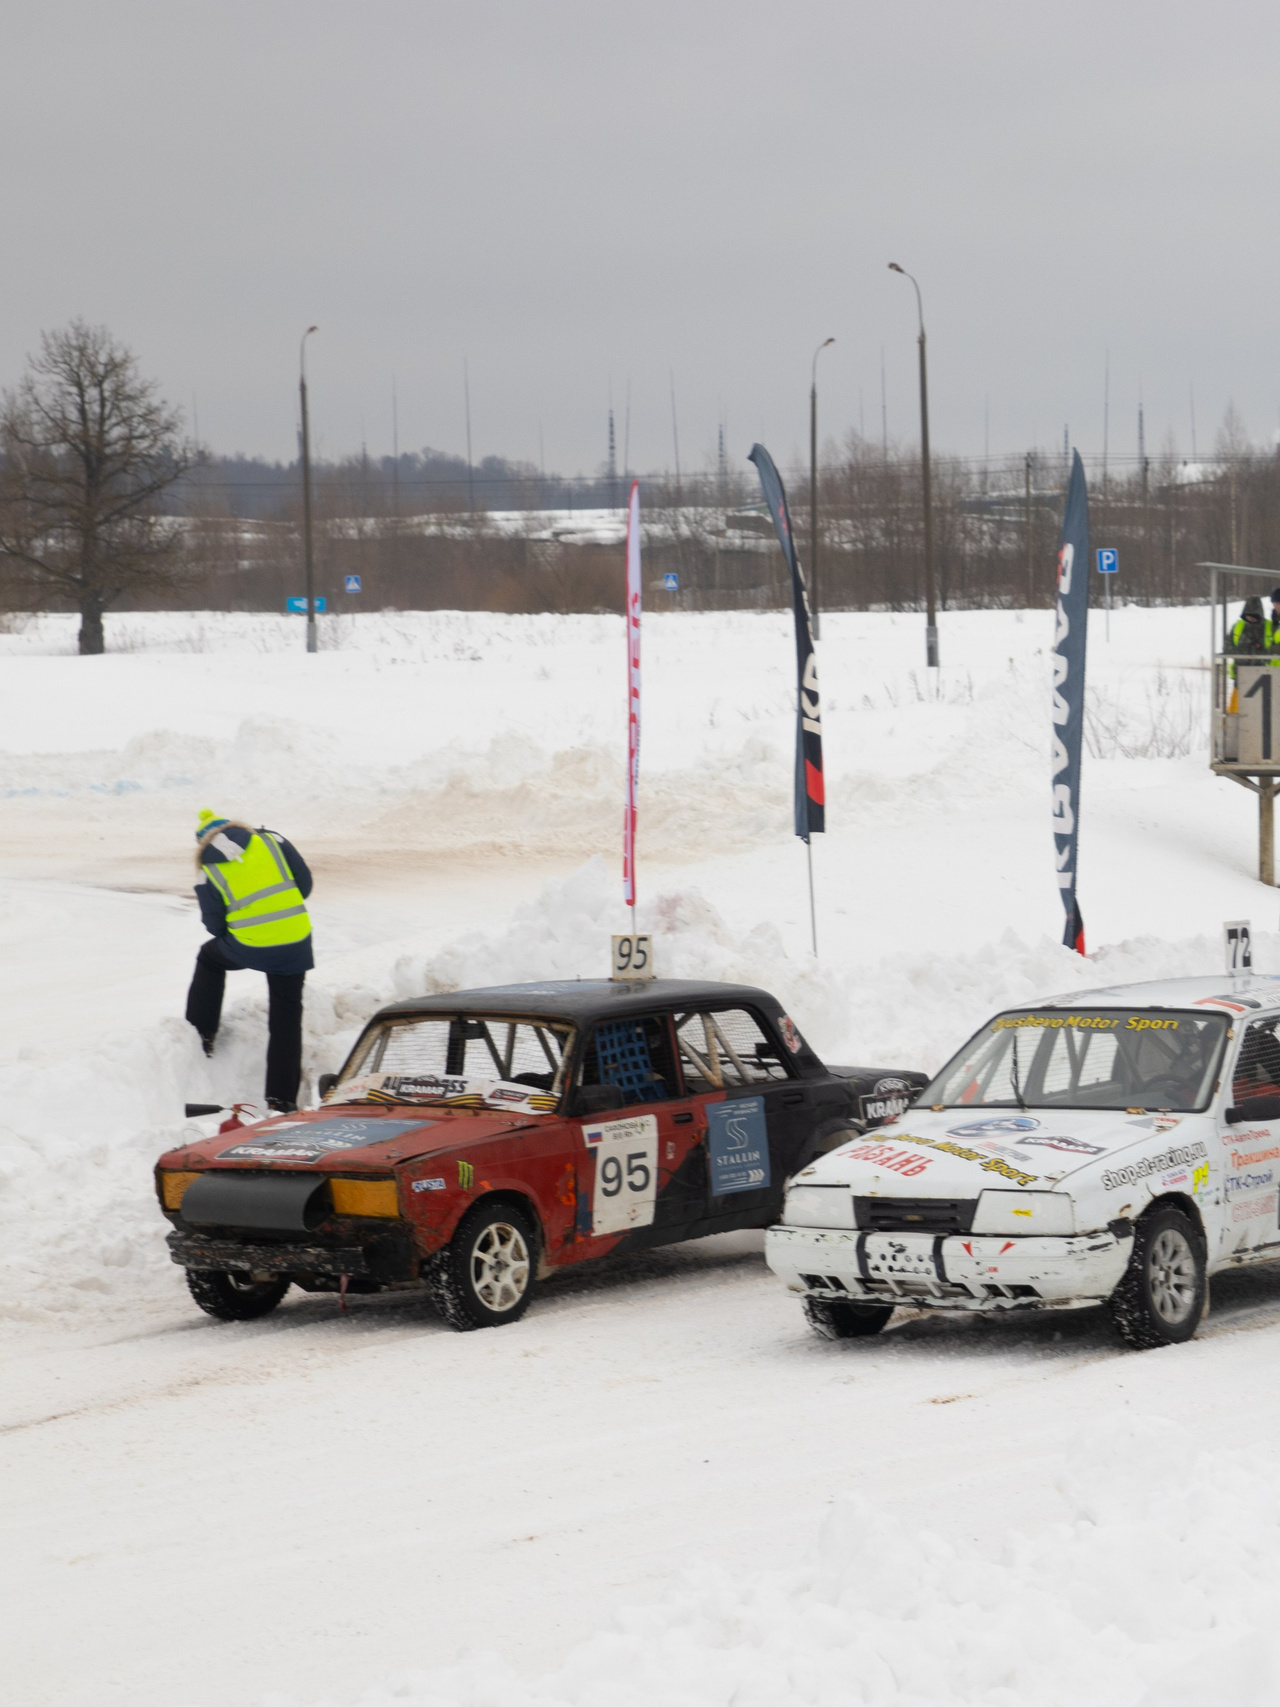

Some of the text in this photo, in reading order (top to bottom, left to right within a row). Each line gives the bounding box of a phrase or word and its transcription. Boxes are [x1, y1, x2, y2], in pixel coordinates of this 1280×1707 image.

[1244, 674, 1272, 760] 1
[617, 937, 648, 970] 95
[1227, 926, 1251, 969] 72
[866, 1097, 910, 1119] KRAM
[230, 1144, 319, 1157] KRAMAR
[716, 1151, 761, 1167] STALLIN
[601, 1151, 650, 1197] 95
[979, 1157, 1040, 1187] Sport
